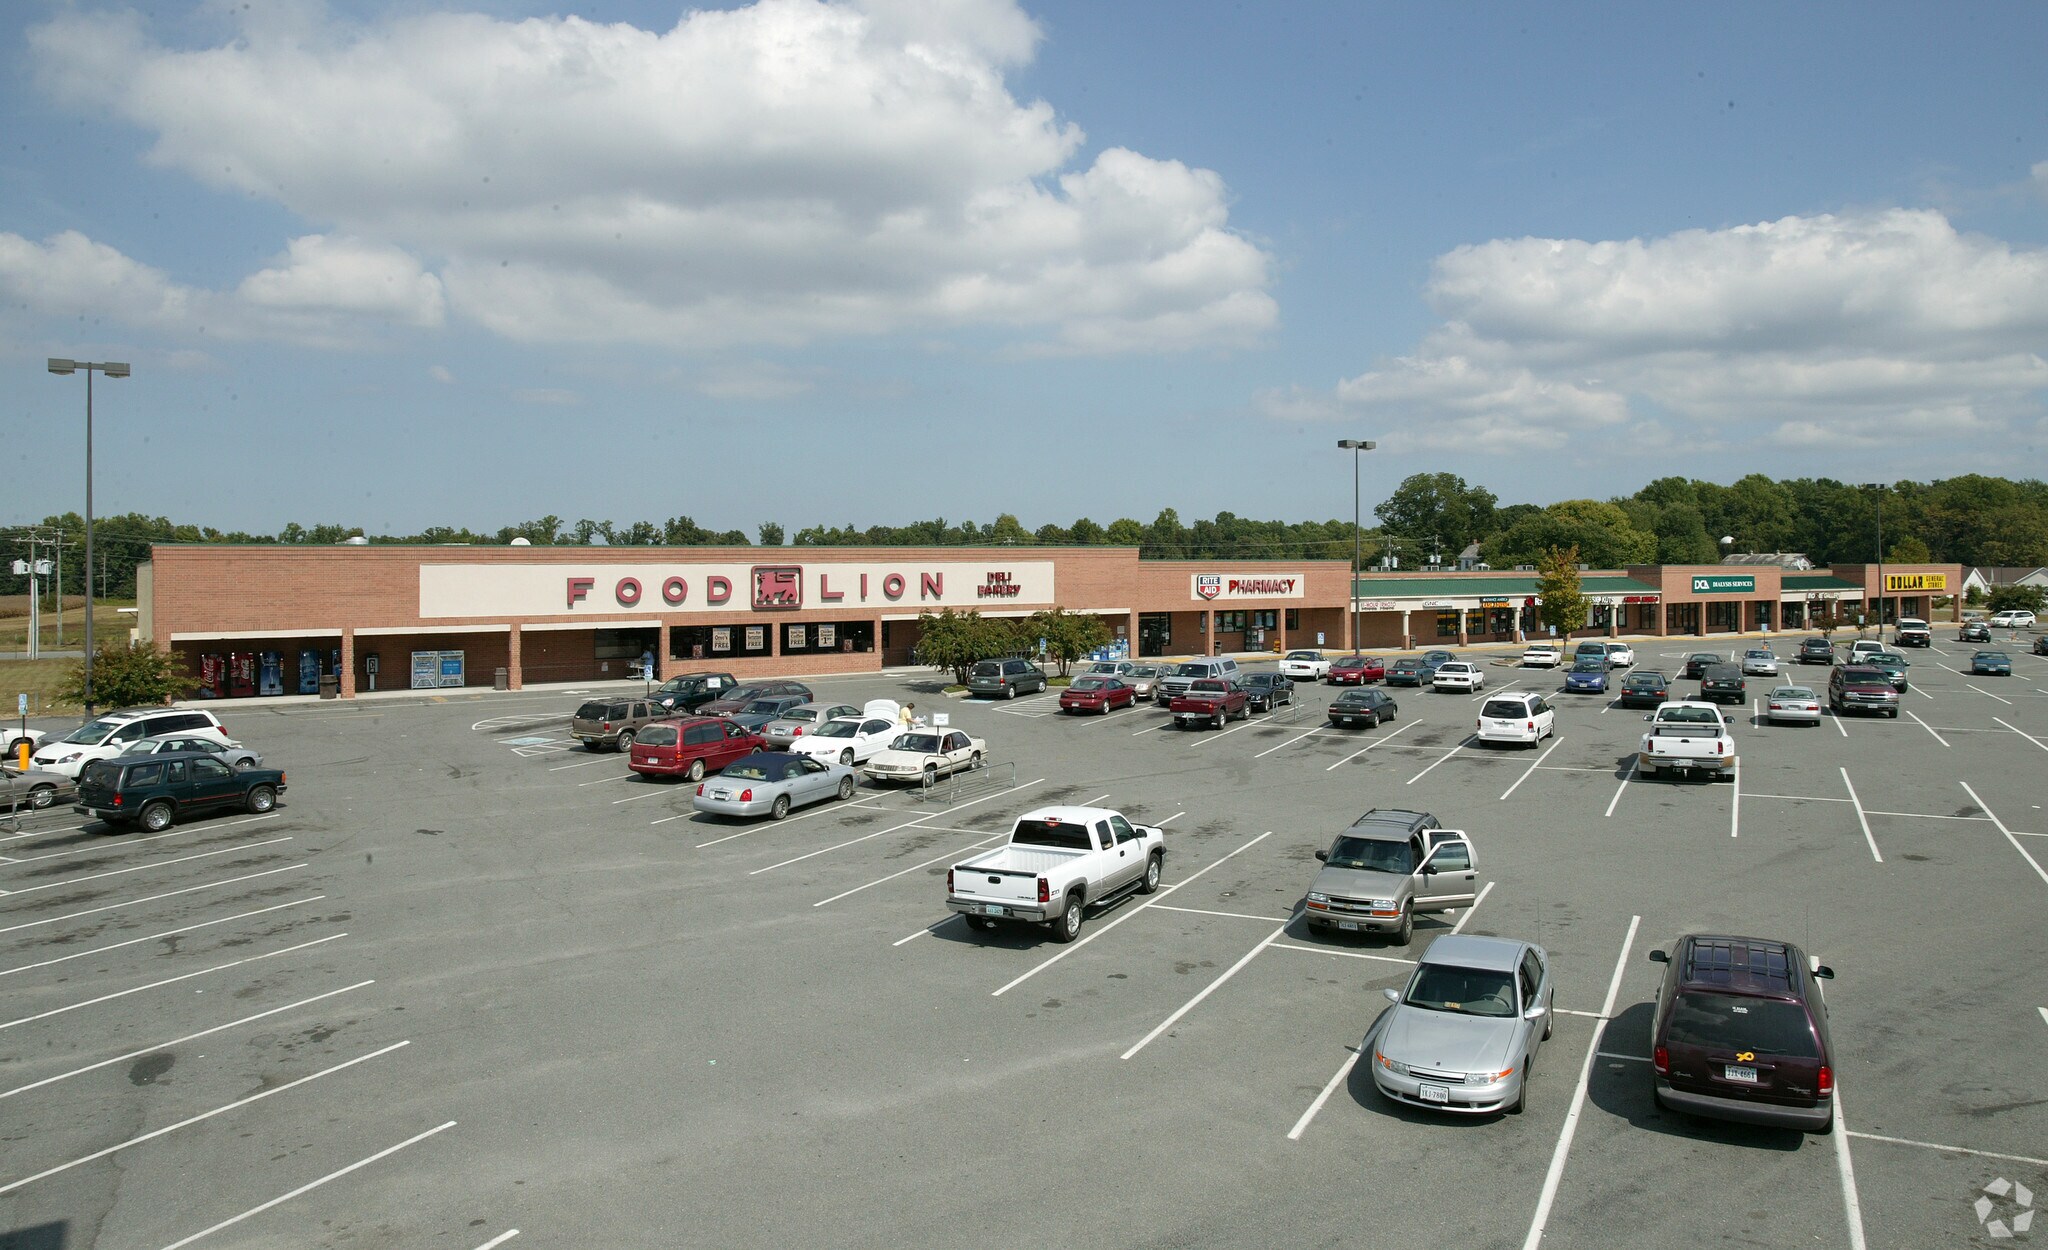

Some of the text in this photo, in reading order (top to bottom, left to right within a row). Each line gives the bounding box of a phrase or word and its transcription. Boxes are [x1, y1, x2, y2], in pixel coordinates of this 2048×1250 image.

[987, 572, 1011, 582] DELI
[1891, 576, 1923, 589] DOLLAR
[567, 572, 943, 605] FOOD LION
[977, 585, 1021, 595] BAKERY
[1203, 586, 1217, 594] AID
[1229, 579, 1296, 594] PHARMACY
